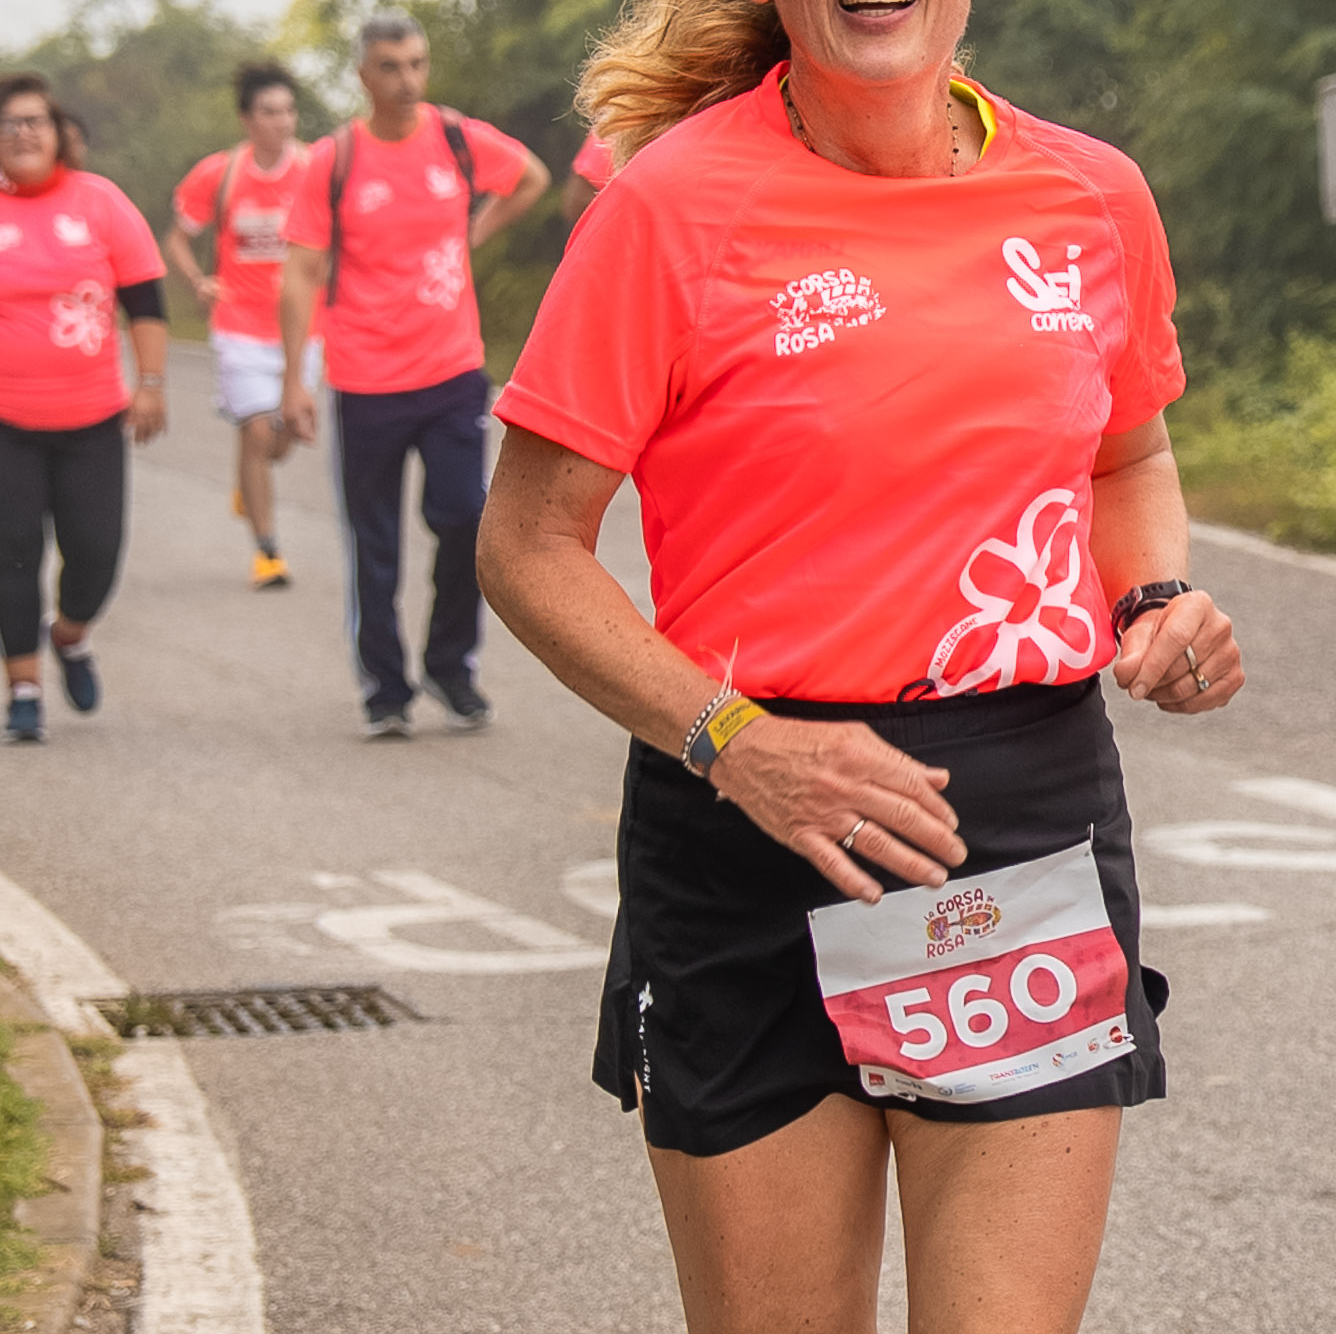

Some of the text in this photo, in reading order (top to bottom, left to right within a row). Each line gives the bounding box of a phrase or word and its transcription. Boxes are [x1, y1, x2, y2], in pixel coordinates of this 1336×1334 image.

[786, 268, 855, 298] CORSA
[1030, 312, 1095, 333] correre
[775, 322, 835, 356] ROSA
[936, 888, 983, 915] CORSA
[926, 934, 965, 959] ROSA
[884, 953, 1078, 1061] 560
